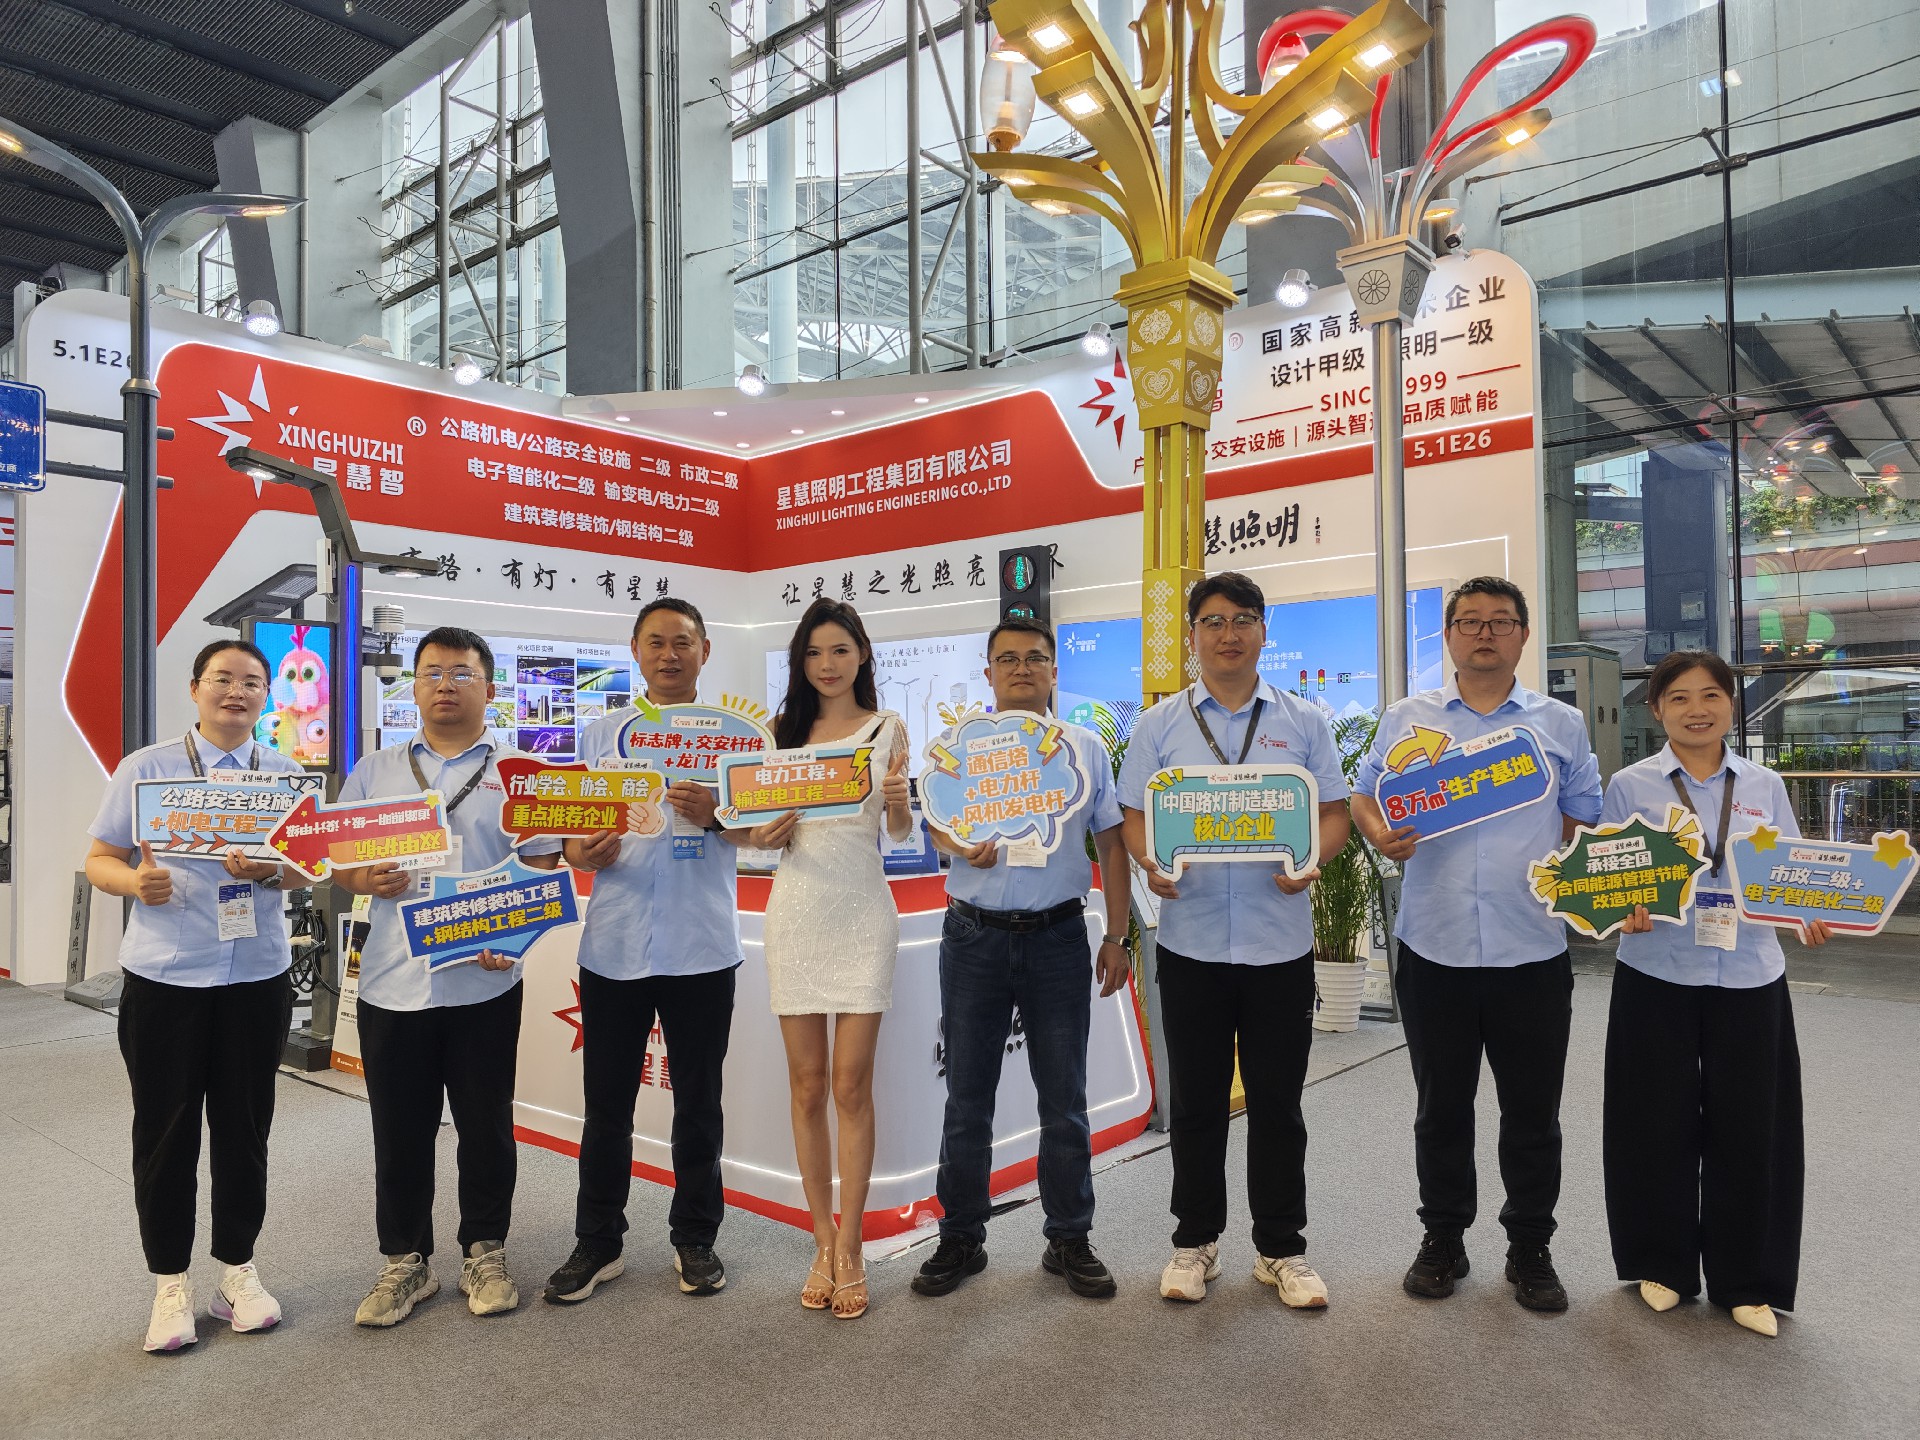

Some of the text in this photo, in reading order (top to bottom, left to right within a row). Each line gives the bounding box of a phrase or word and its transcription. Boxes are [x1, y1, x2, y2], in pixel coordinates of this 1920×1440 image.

[1271, 347, 1366, 388] 设计甲级
[1320, 371, 1447, 412] SINC 999
[1307, 389, 1498, 443] 源头智 品质赋能
[278, 422, 404, 466] XINGHUIZHI
[440, 416, 740, 491] 公路机电/公路安全设施 二级 市政二级
[1414, 428, 1492, 460] 5.1E26
[313, 456, 404, 496] 星慧智
[467, 457, 720, 518] 电子智能化二级 输变电/电力二级
[776, 439, 1012, 512] 星慧照明工程集团有限公司
[776, 475, 1012, 531] XINGHUI LIGHTING ENGINEERING CO.,LTD
[504, 502, 695, 548] 建筑装修装饰/钢结构二级
[1204, 503, 1300, 557] 慧照明
[629, 731, 765, 752] 标志牌+交安杆件
[755, 763, 838, 786] 电力工程+
[966, 745, 1029, 777] 通信塔
[160, 786, 296, 813] 公路安全设施
[509, 773, 650, 798] 行业学会、协会、商会
[734, 780, 862, 809] 输变电工程二级
[964, 769, 1042, 801] +电力杆
[1163, 788, 1295, 814] 中国路灯制造基地
[149, 810, 279, 834] +机电工程二
[511, 804, 619, 830] 重点推荐企业
[949, 787, 1066, 829] +风机发电杆
[1193, 812, 1276, 843] 核心企业
[354, 831, 442, 861] 双甲护航
[1586, 851, 1653, 874] 承接全国
[1769, 864, 1865, 891] 市政二级+
[1556, 863, 1690, 897] 合同能源管理节能
[413, 880, 562, 928] 建筑装修装饰工程
[1591, 887, 1659, 910] 改造项目
[1743, 883, 1886, 915] 电子智能化二级
[421, 901, 563, 947] +钢结构工程二级
